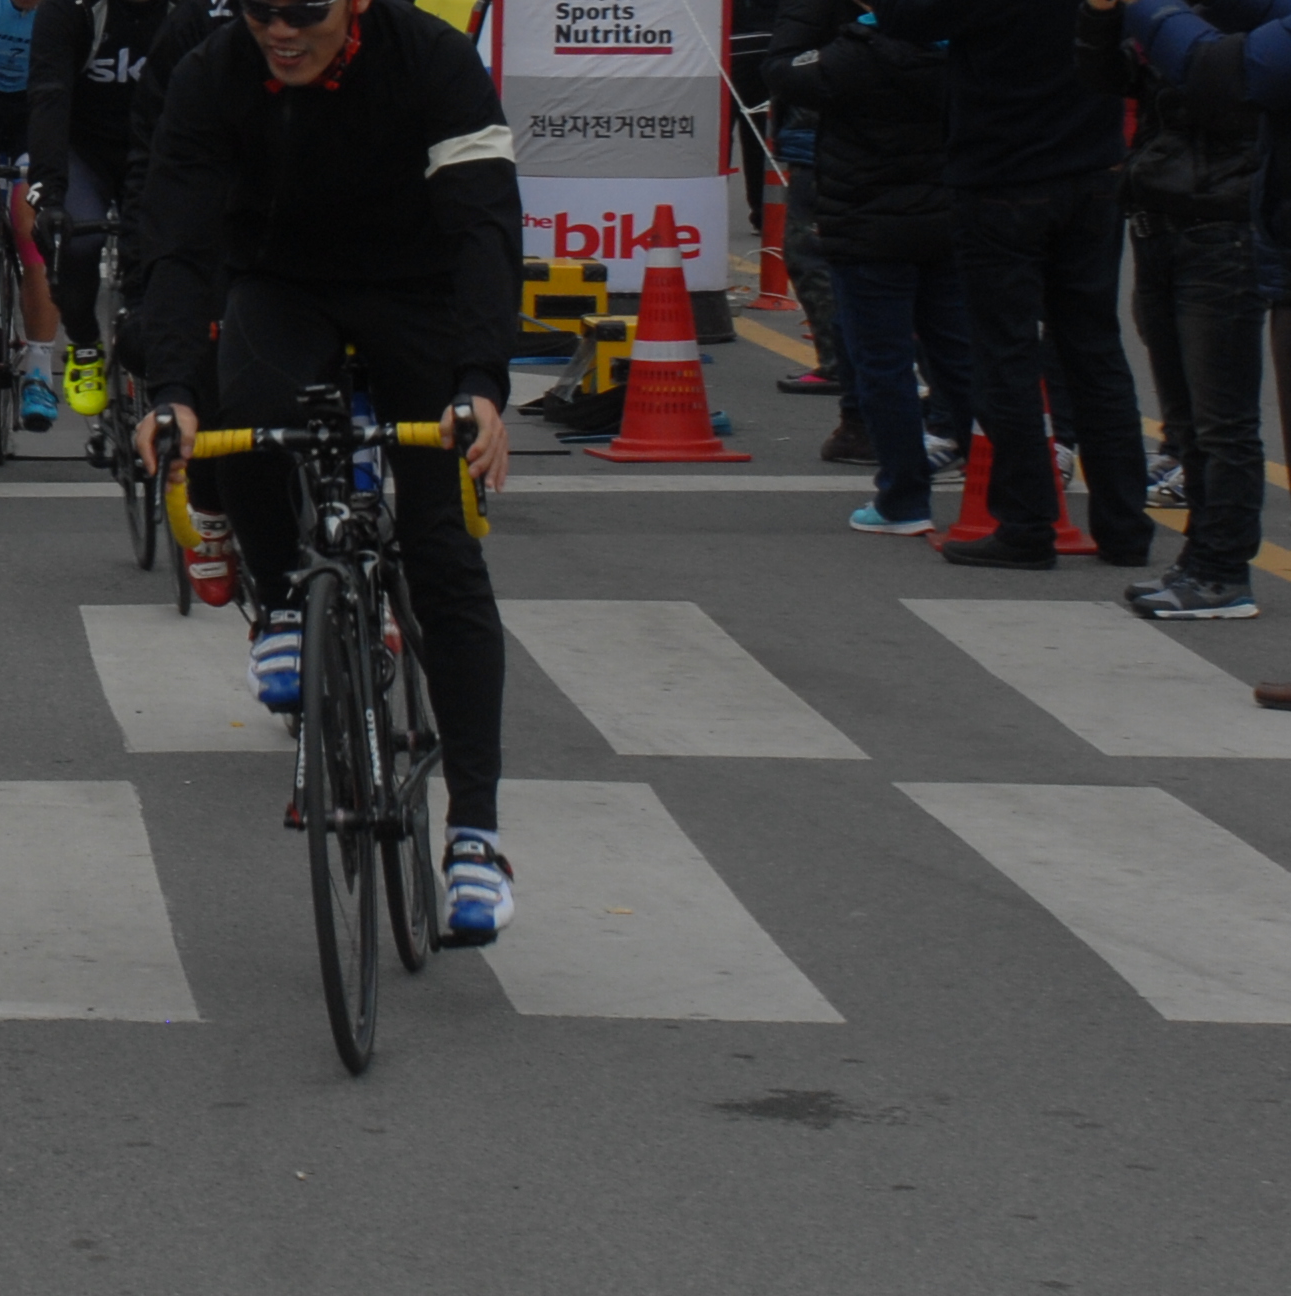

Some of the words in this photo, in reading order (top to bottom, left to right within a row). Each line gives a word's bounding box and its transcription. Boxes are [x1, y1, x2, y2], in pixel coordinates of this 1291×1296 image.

[555, 3, 635, 24] Sports
[554, 24, 673, 45] Nutrition
[86, 46, 148, 84] sk
[529, 115, 695, 138] 전남자전거연합회
[554, 212, 702, 260] bike
